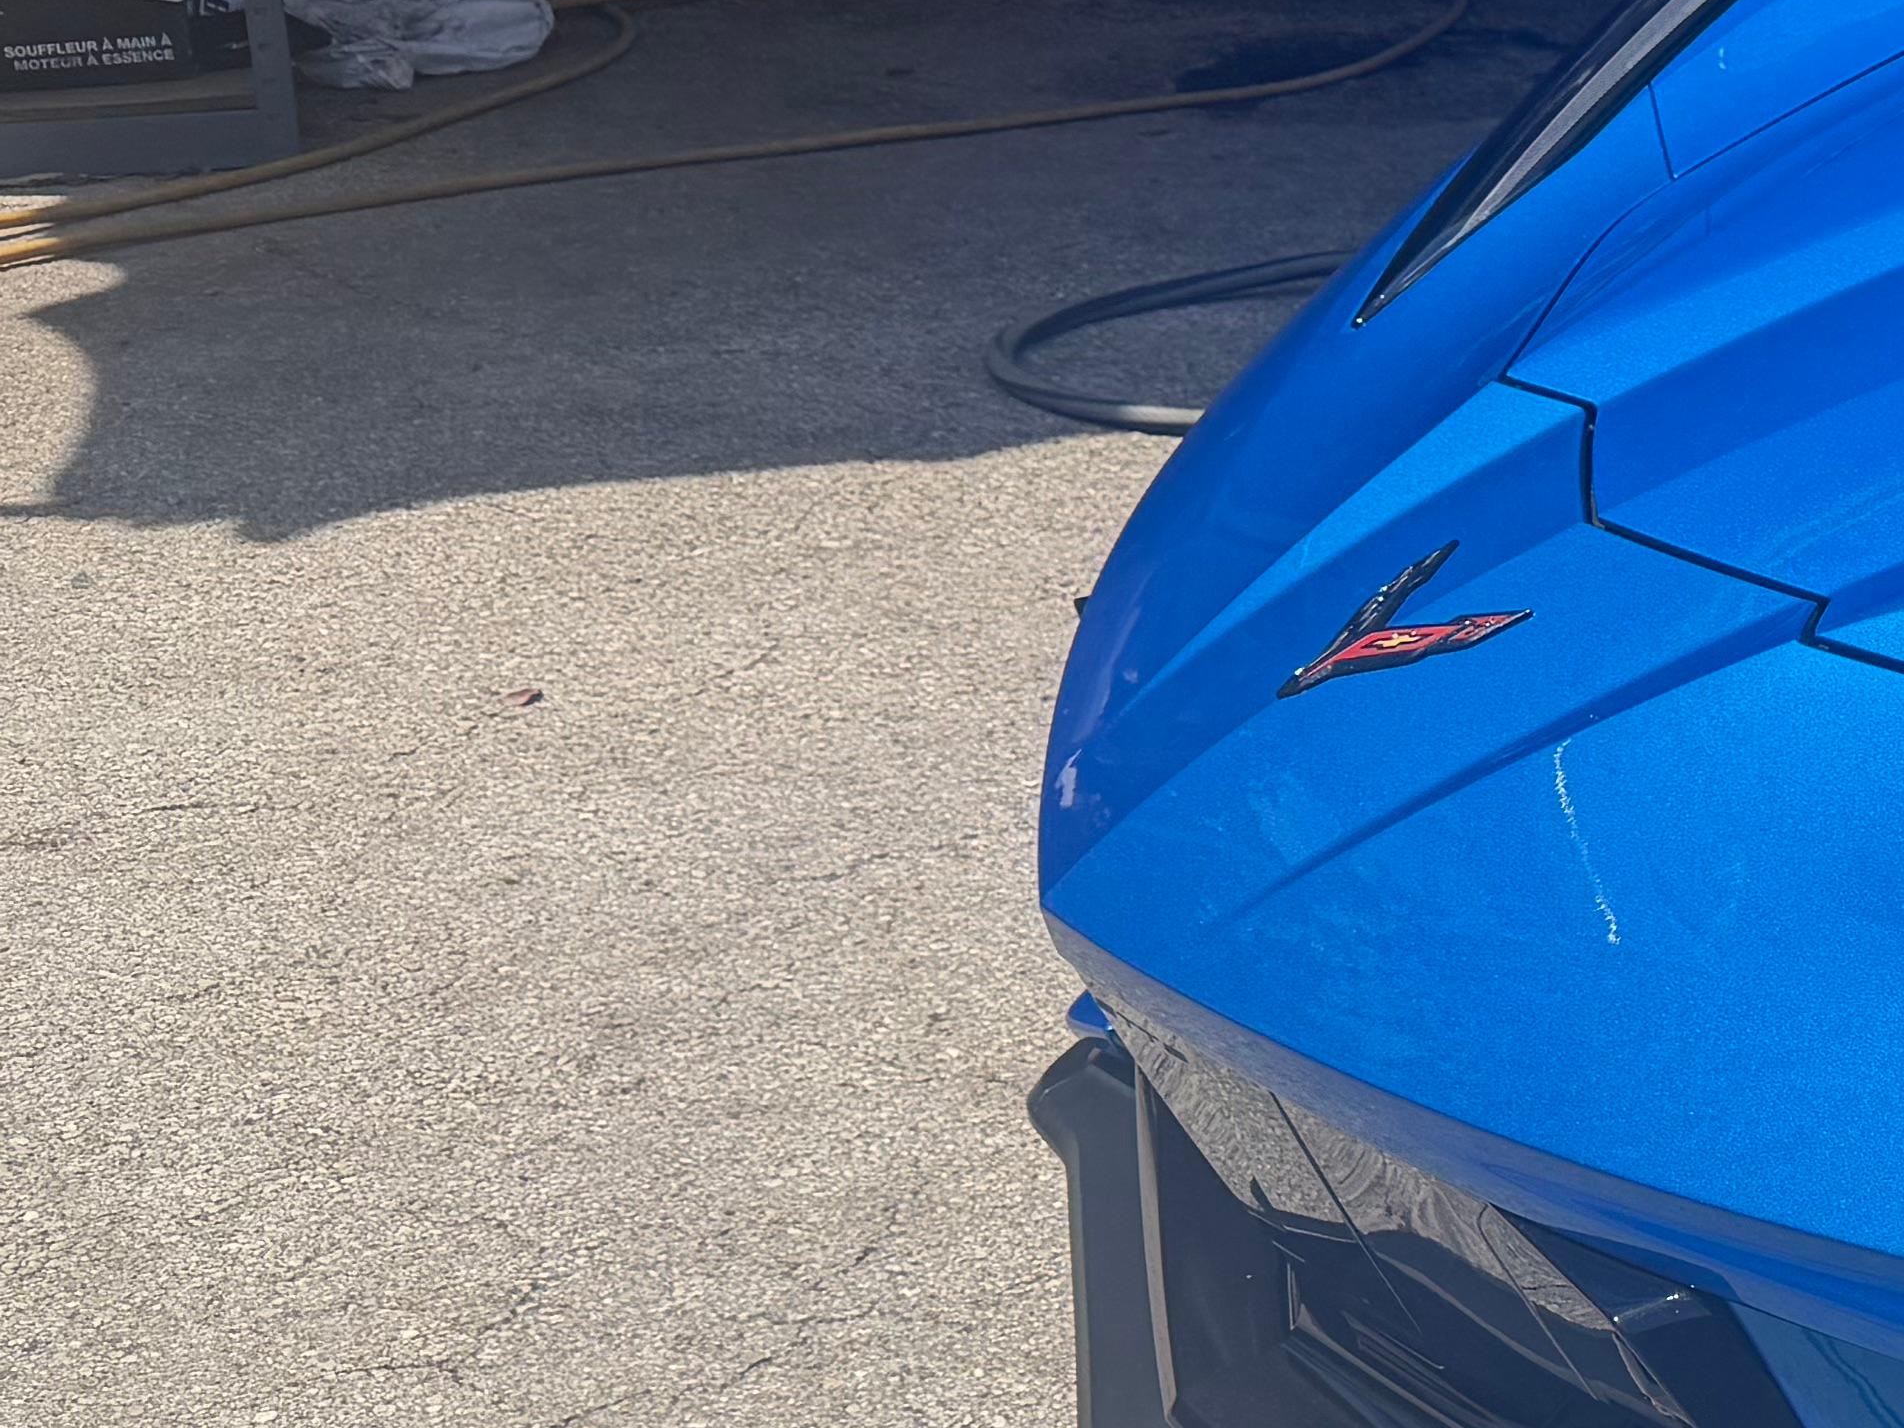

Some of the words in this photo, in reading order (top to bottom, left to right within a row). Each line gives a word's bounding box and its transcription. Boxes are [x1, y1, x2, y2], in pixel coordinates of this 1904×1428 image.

[3, 40, 98, 59] SOUFFLEUR
[102, 36, 114, 50] À
[117, 35, 156, 50] MAIN
[160, 32, 173, 46] À
[13, 56, 83, 71] MOTEUR
[101, 48, 175, 66] ESSENCE
